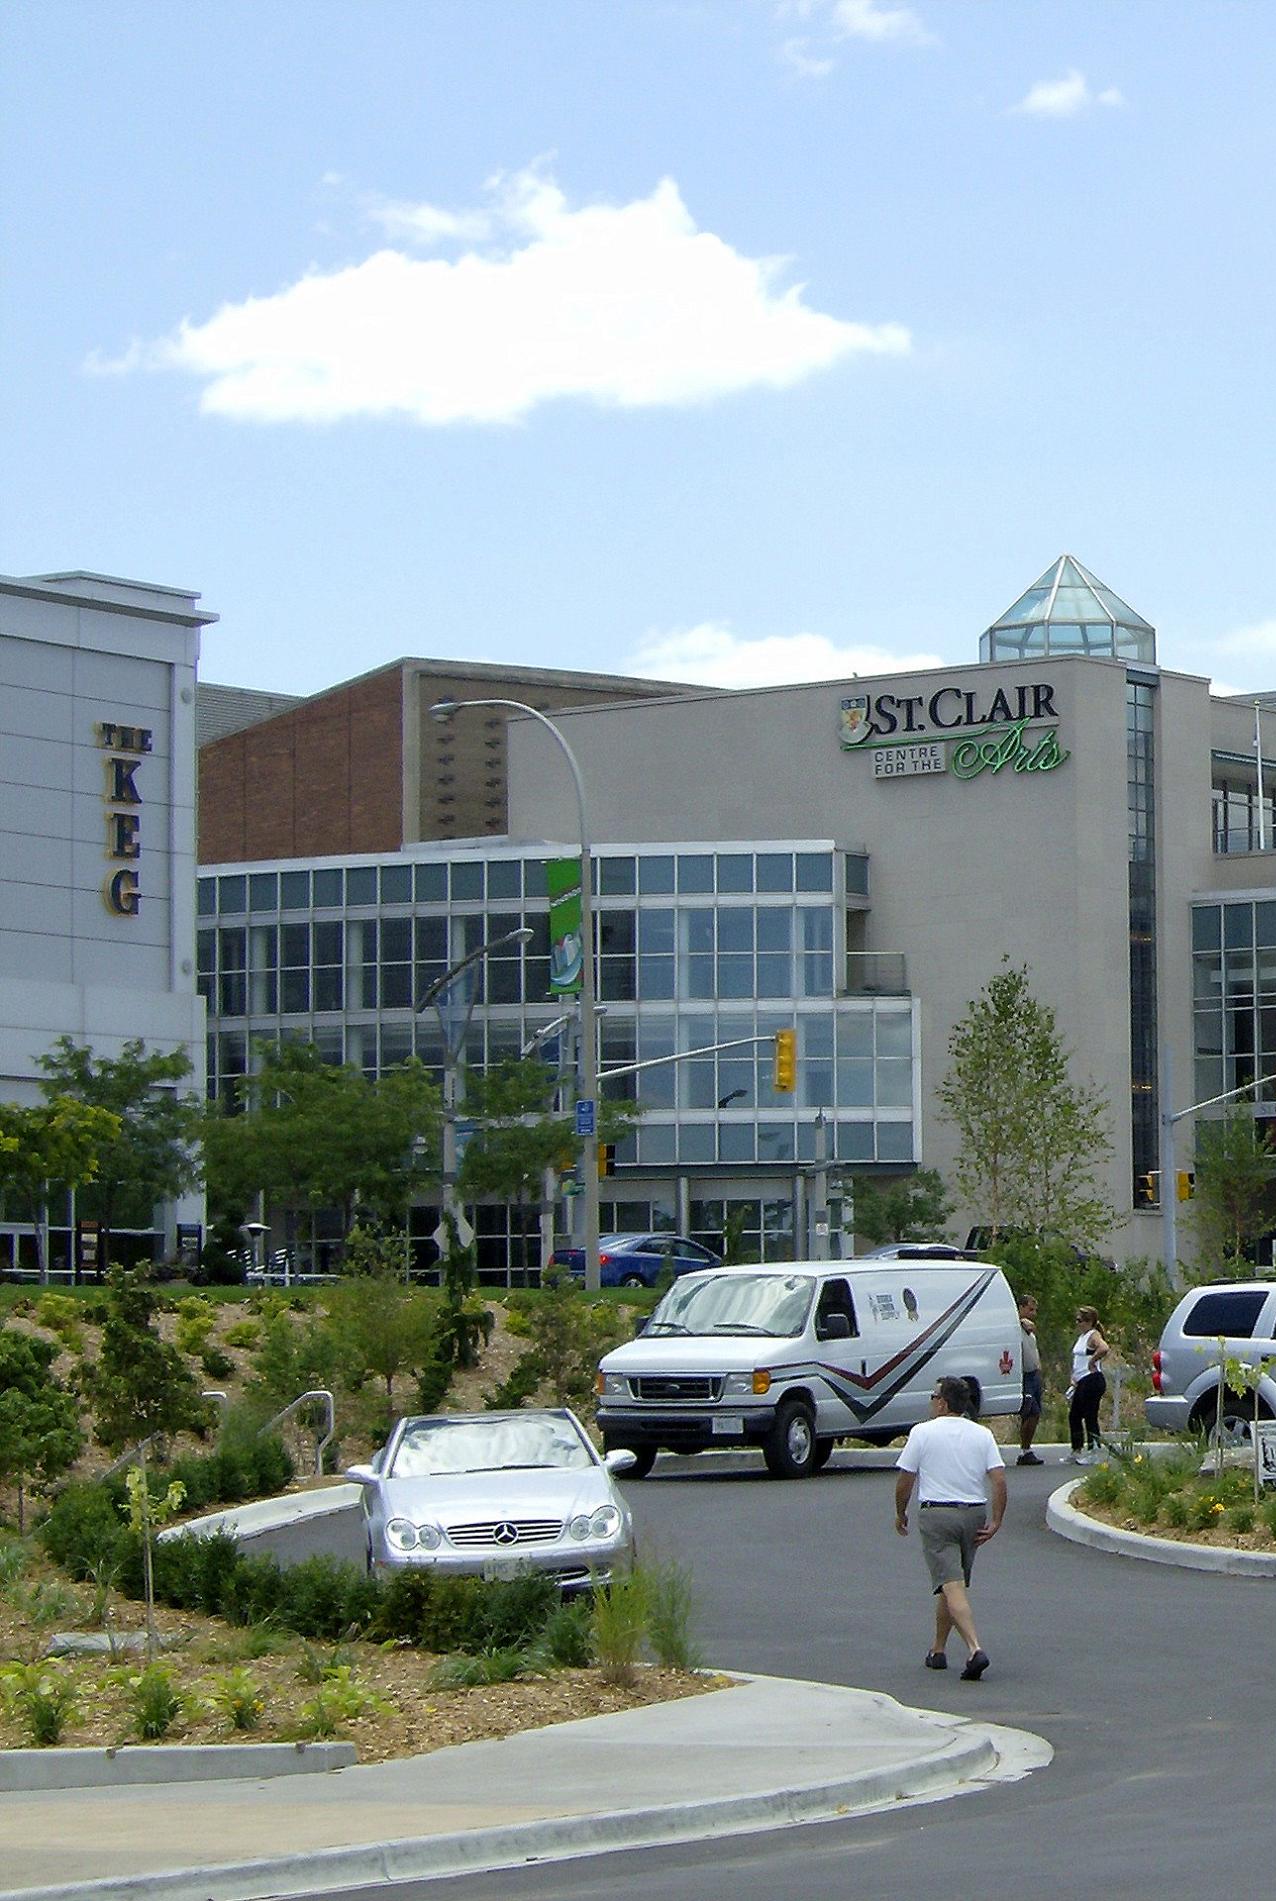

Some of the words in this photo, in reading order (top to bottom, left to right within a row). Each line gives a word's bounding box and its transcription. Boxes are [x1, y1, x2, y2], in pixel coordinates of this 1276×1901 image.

[928, 683, 1059, 728] CLAIR
[97, 722, 153, 752] THE
[874, 745, 938, 764] CENTRE
[953, 716, 1071, 780] Arts
[874, 761, 905, 776] FOR
[912, 758, 942, 772] THE
[103, 757, 143, 917] KEG
